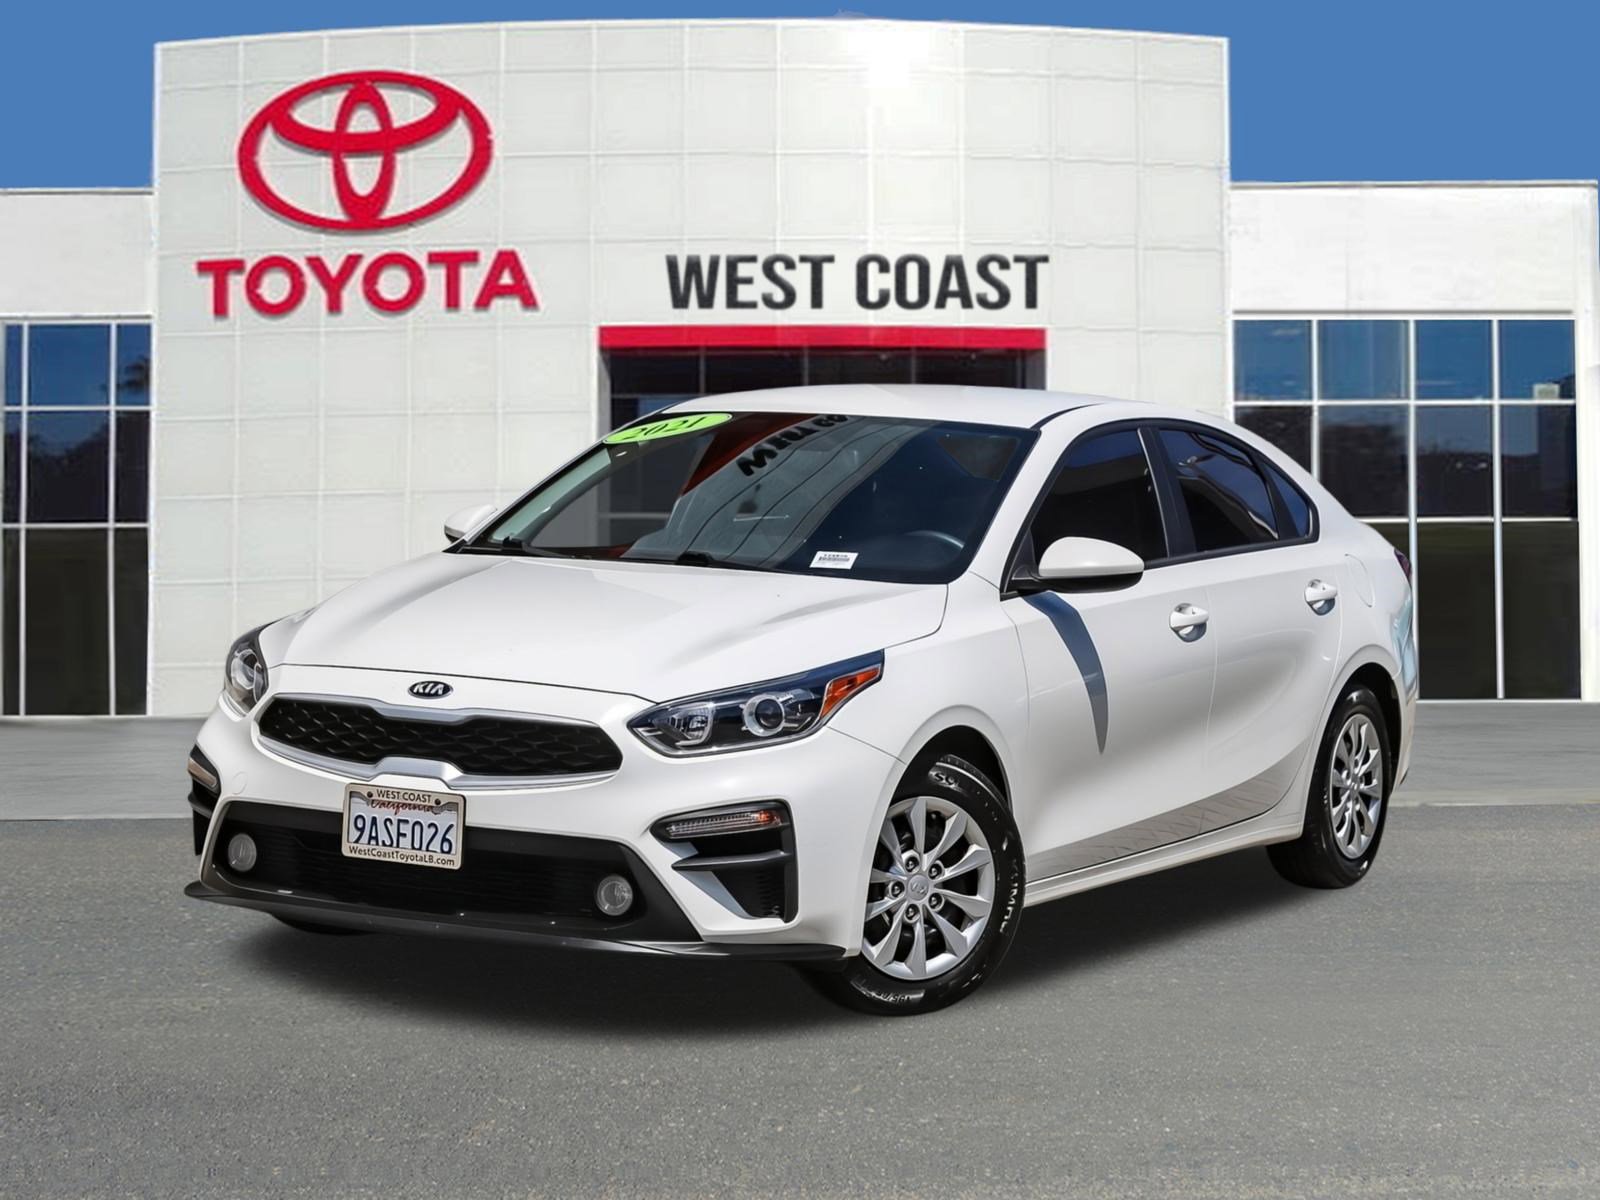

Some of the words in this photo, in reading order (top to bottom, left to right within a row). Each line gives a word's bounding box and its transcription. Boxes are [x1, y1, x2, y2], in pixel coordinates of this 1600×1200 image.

[197, 249, 540, 318] TOYOTA
[666, 253, 835, 310] WEST
[855, 253, 1050, 310] COAST
[622, 416, 708, 440] 2021
[412, 681, 446, 695] KIA
[376, 788, 400, 800] WEST
[402, 791, 432, 804] COAST
[352, 814, 455, 855] 9ASF026
[348, 845, 455, 866] WestCoastToyotaLB.com
